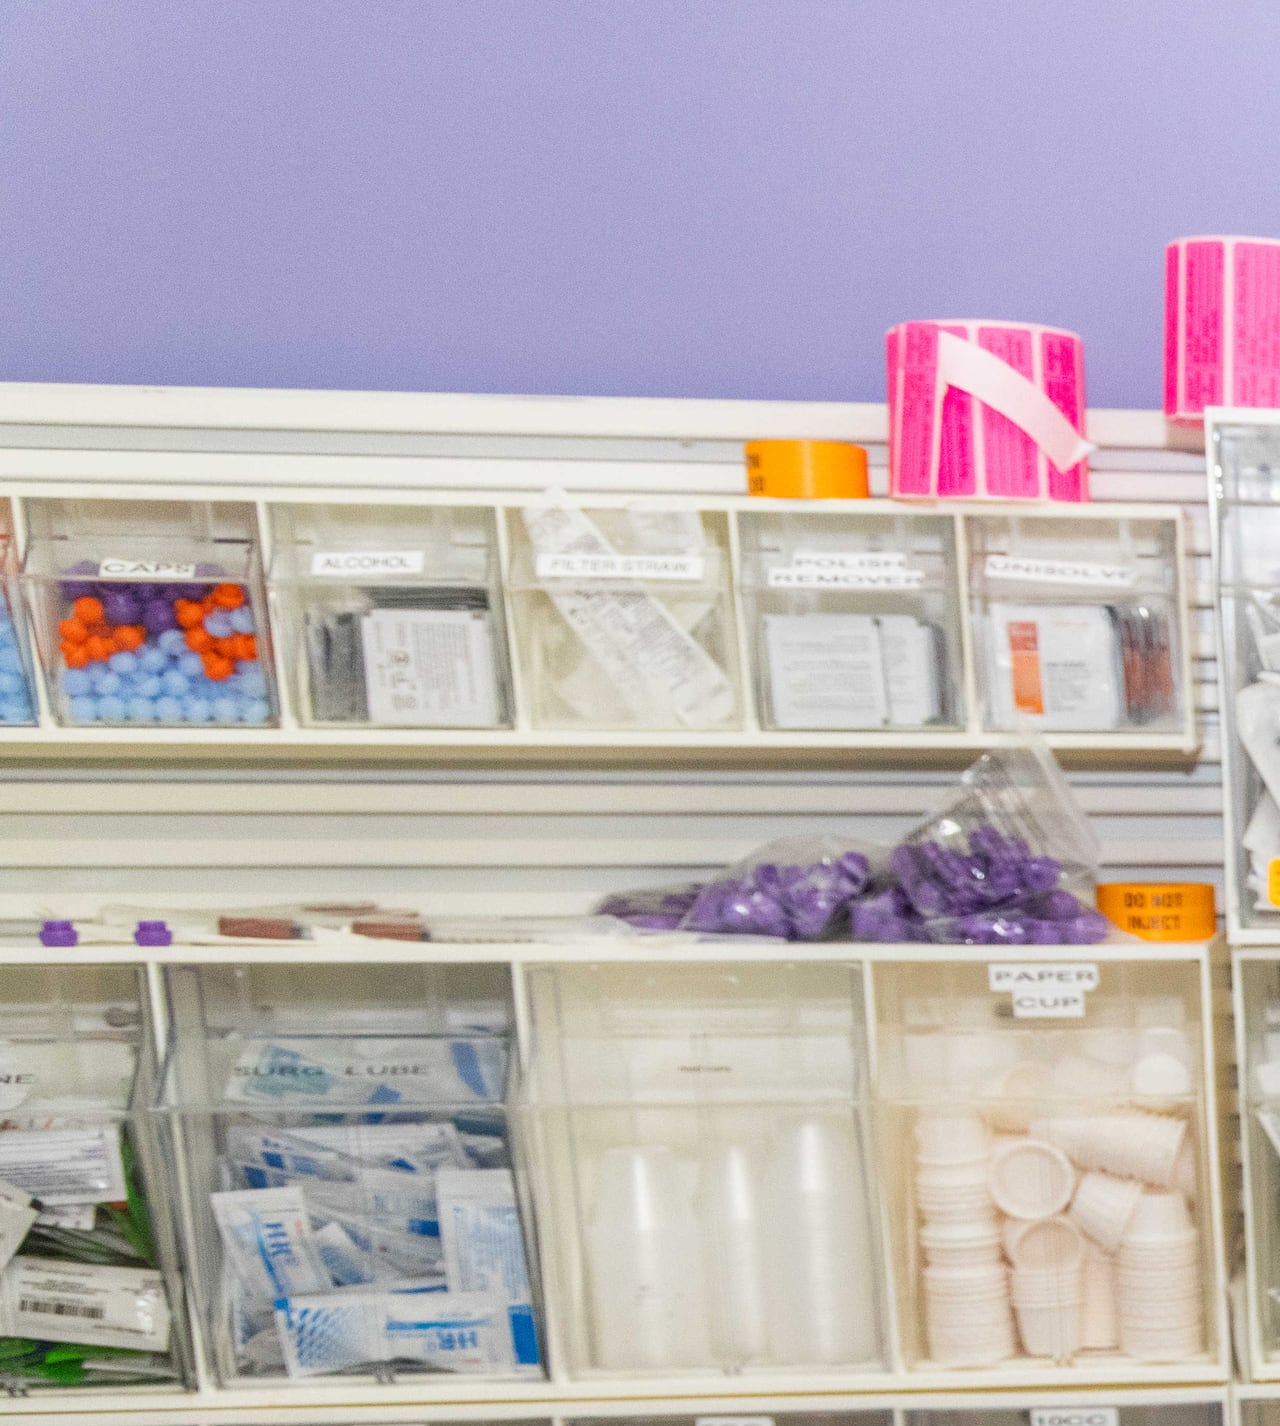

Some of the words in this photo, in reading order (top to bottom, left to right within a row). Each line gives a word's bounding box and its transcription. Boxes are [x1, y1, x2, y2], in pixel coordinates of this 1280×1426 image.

[104, 563, 190, 574] CAPS
[321, 556, 410, 570] ALCOHOL
[551, 559, 616, 572] FILTER
[622, 560, 688, 573] STRAW
[795, 558, 906, 568] POLISH
[989, 562, 1132, 579] UNISOLVE
[774, 574, 925, 585] REMOVER
[1124, 892, 1144, 908] DO
[1128, 914, 1180, 930] INJECT
[993, 970, 1095, 984] PAPER
[1015, 996, 1079, 1009] CUP
[235, 1065, 325, 1077] SURG
[345, 1063, 429, 1076] LUBE
[1038, 1414, 1106, 1426] 10CC
